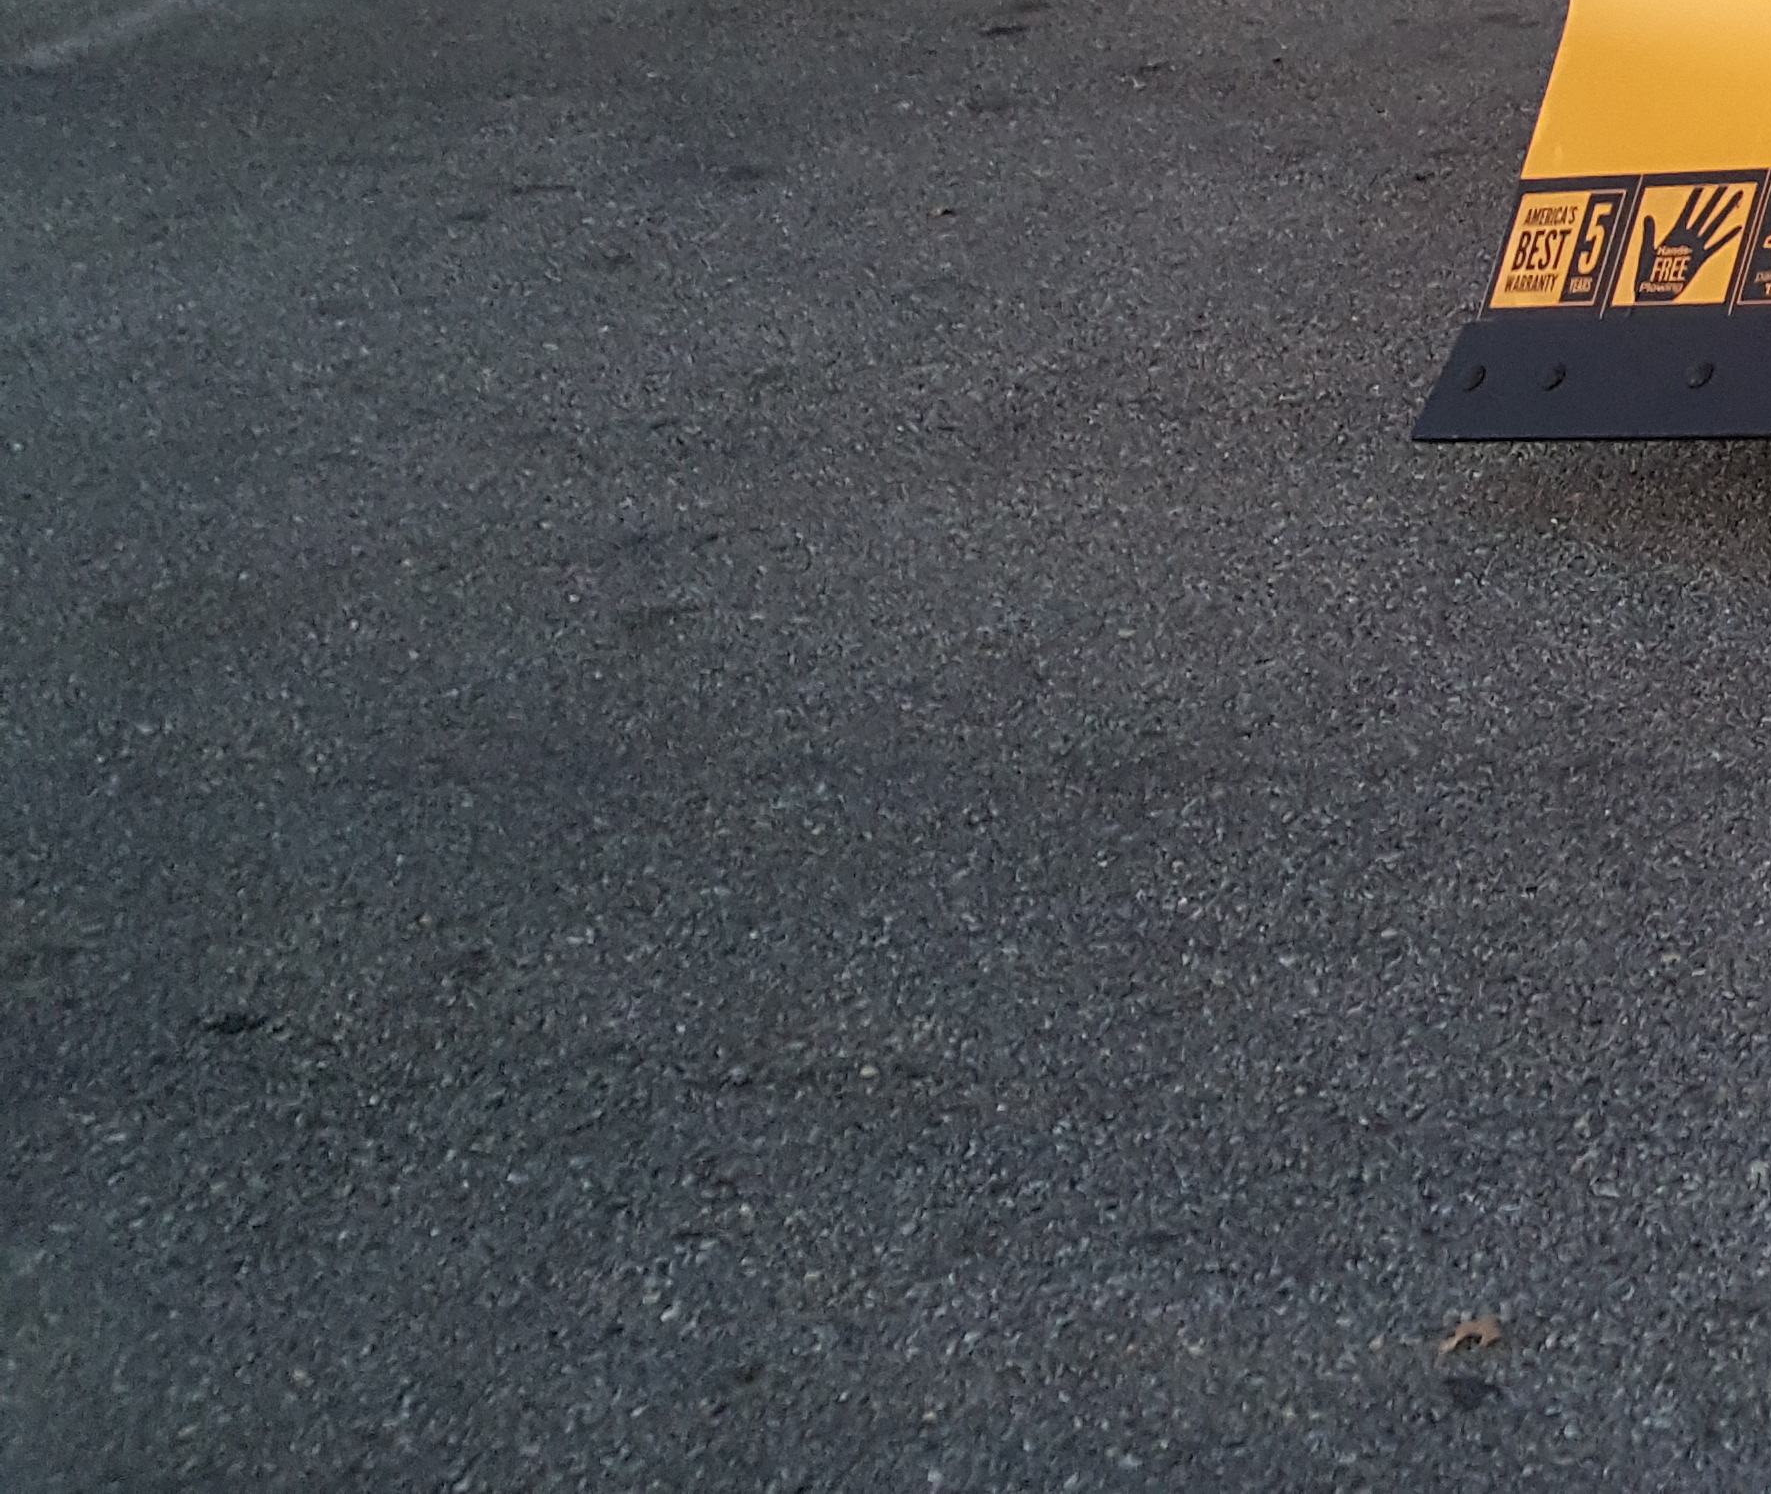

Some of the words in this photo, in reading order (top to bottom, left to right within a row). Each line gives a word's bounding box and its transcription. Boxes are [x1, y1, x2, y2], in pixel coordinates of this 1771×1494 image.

[1524, 206, 1578, 226] AMERICA'S
[1511, 228, 1573, 271] BEST
[1577, 202, 1613, 275] 5
[1649, 255, 1692, 282] FREE
[1504, 274, 1559, 294] WARRANTY
